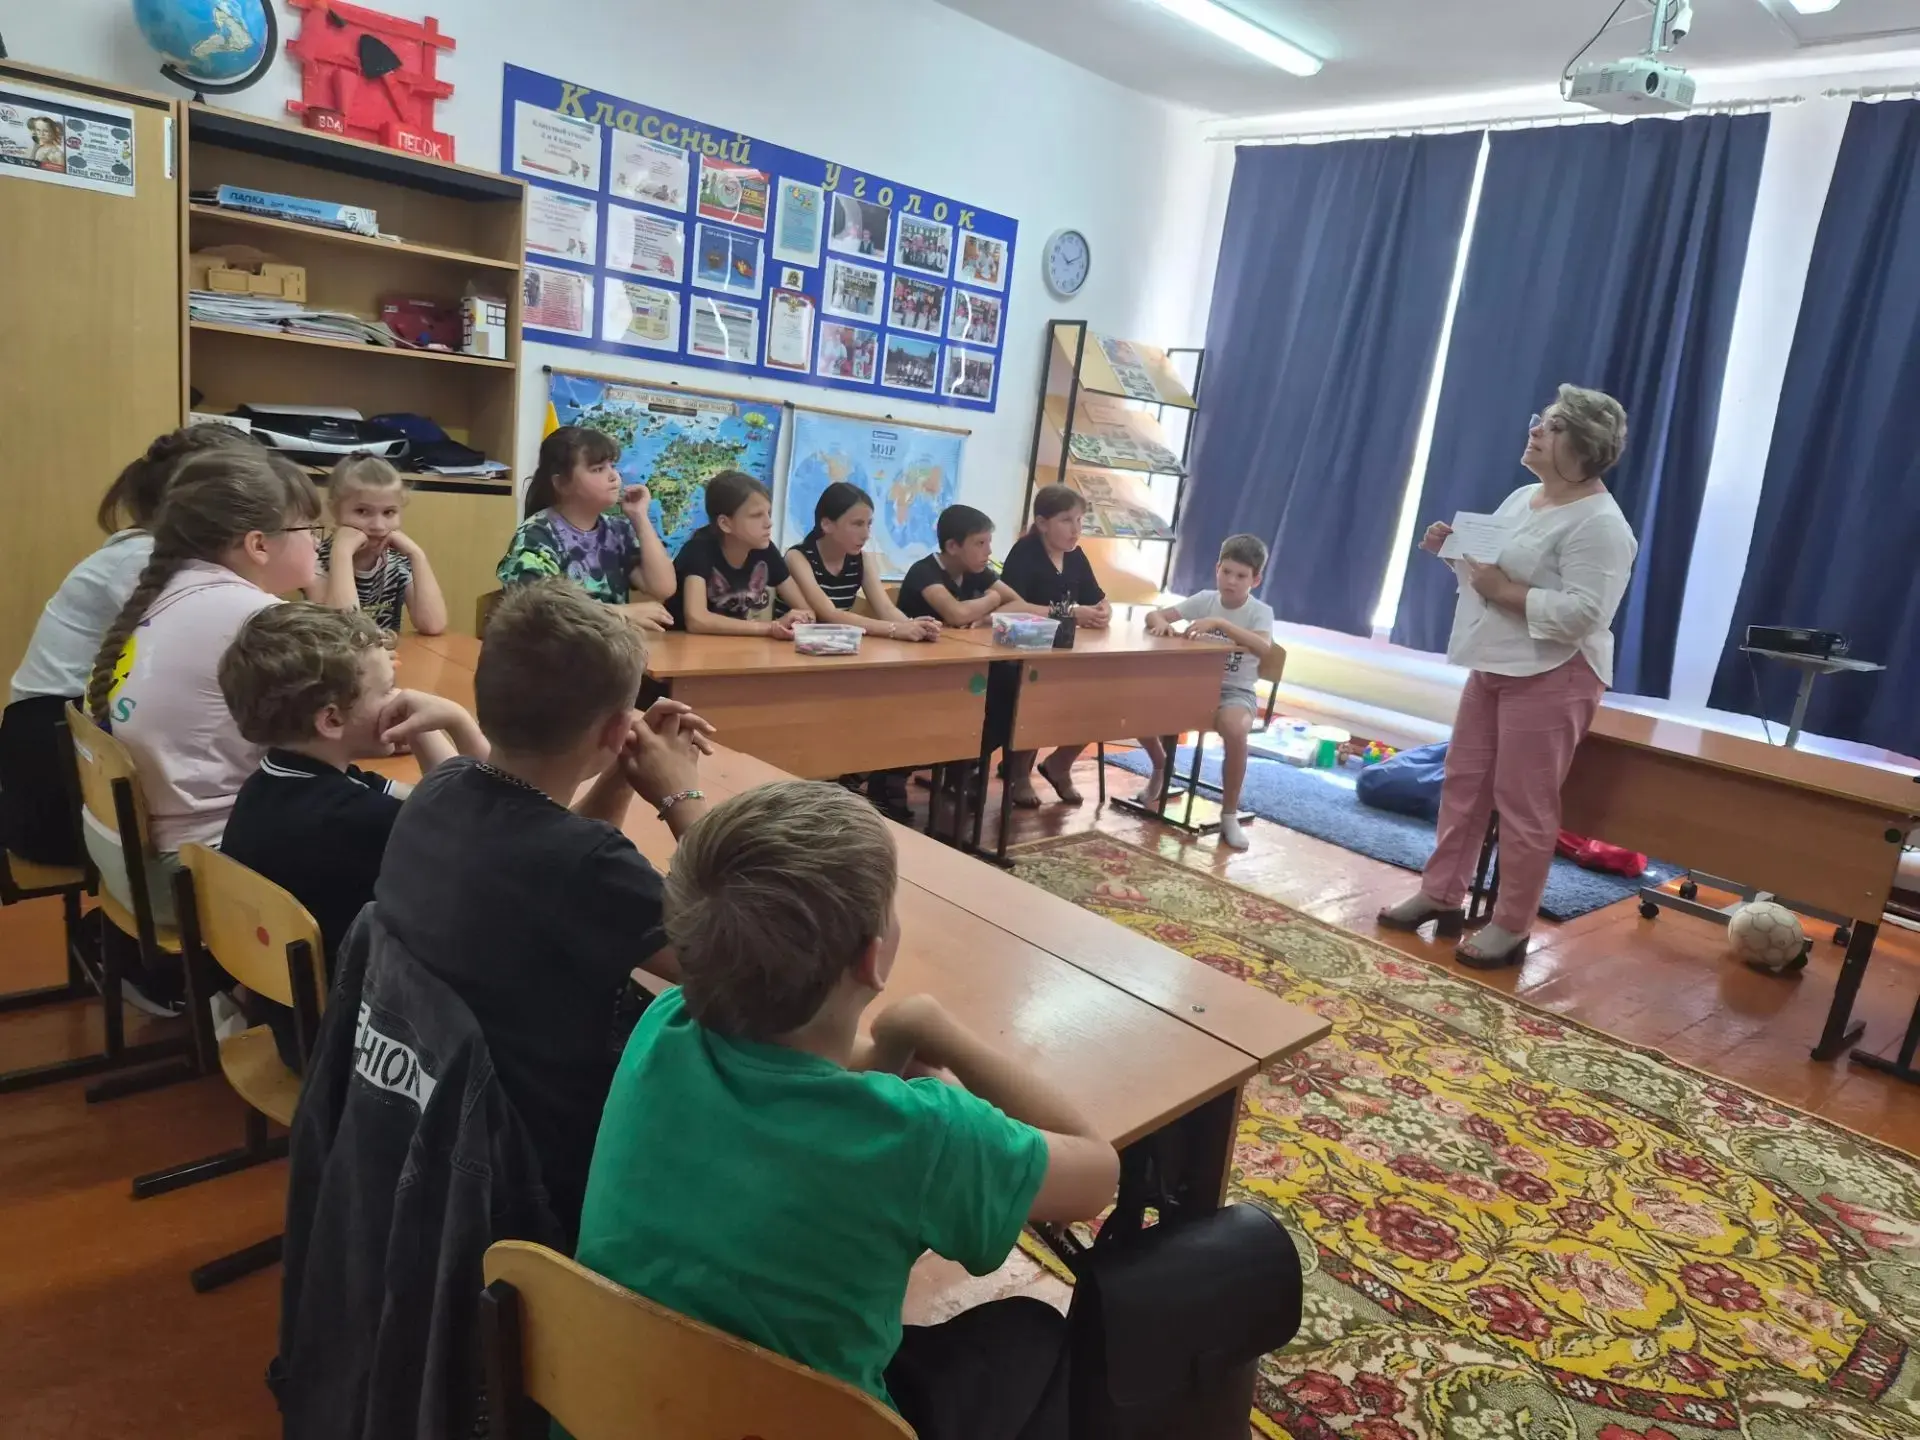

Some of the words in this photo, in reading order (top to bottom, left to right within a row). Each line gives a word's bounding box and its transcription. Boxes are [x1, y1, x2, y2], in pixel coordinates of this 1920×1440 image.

[556, 82, 751, 165] Классный
[398, 131, 442, 160] ПЕСОК
[229, 192, 265, 205] ПАПКА
[871, 443, 896, 456] МИР
